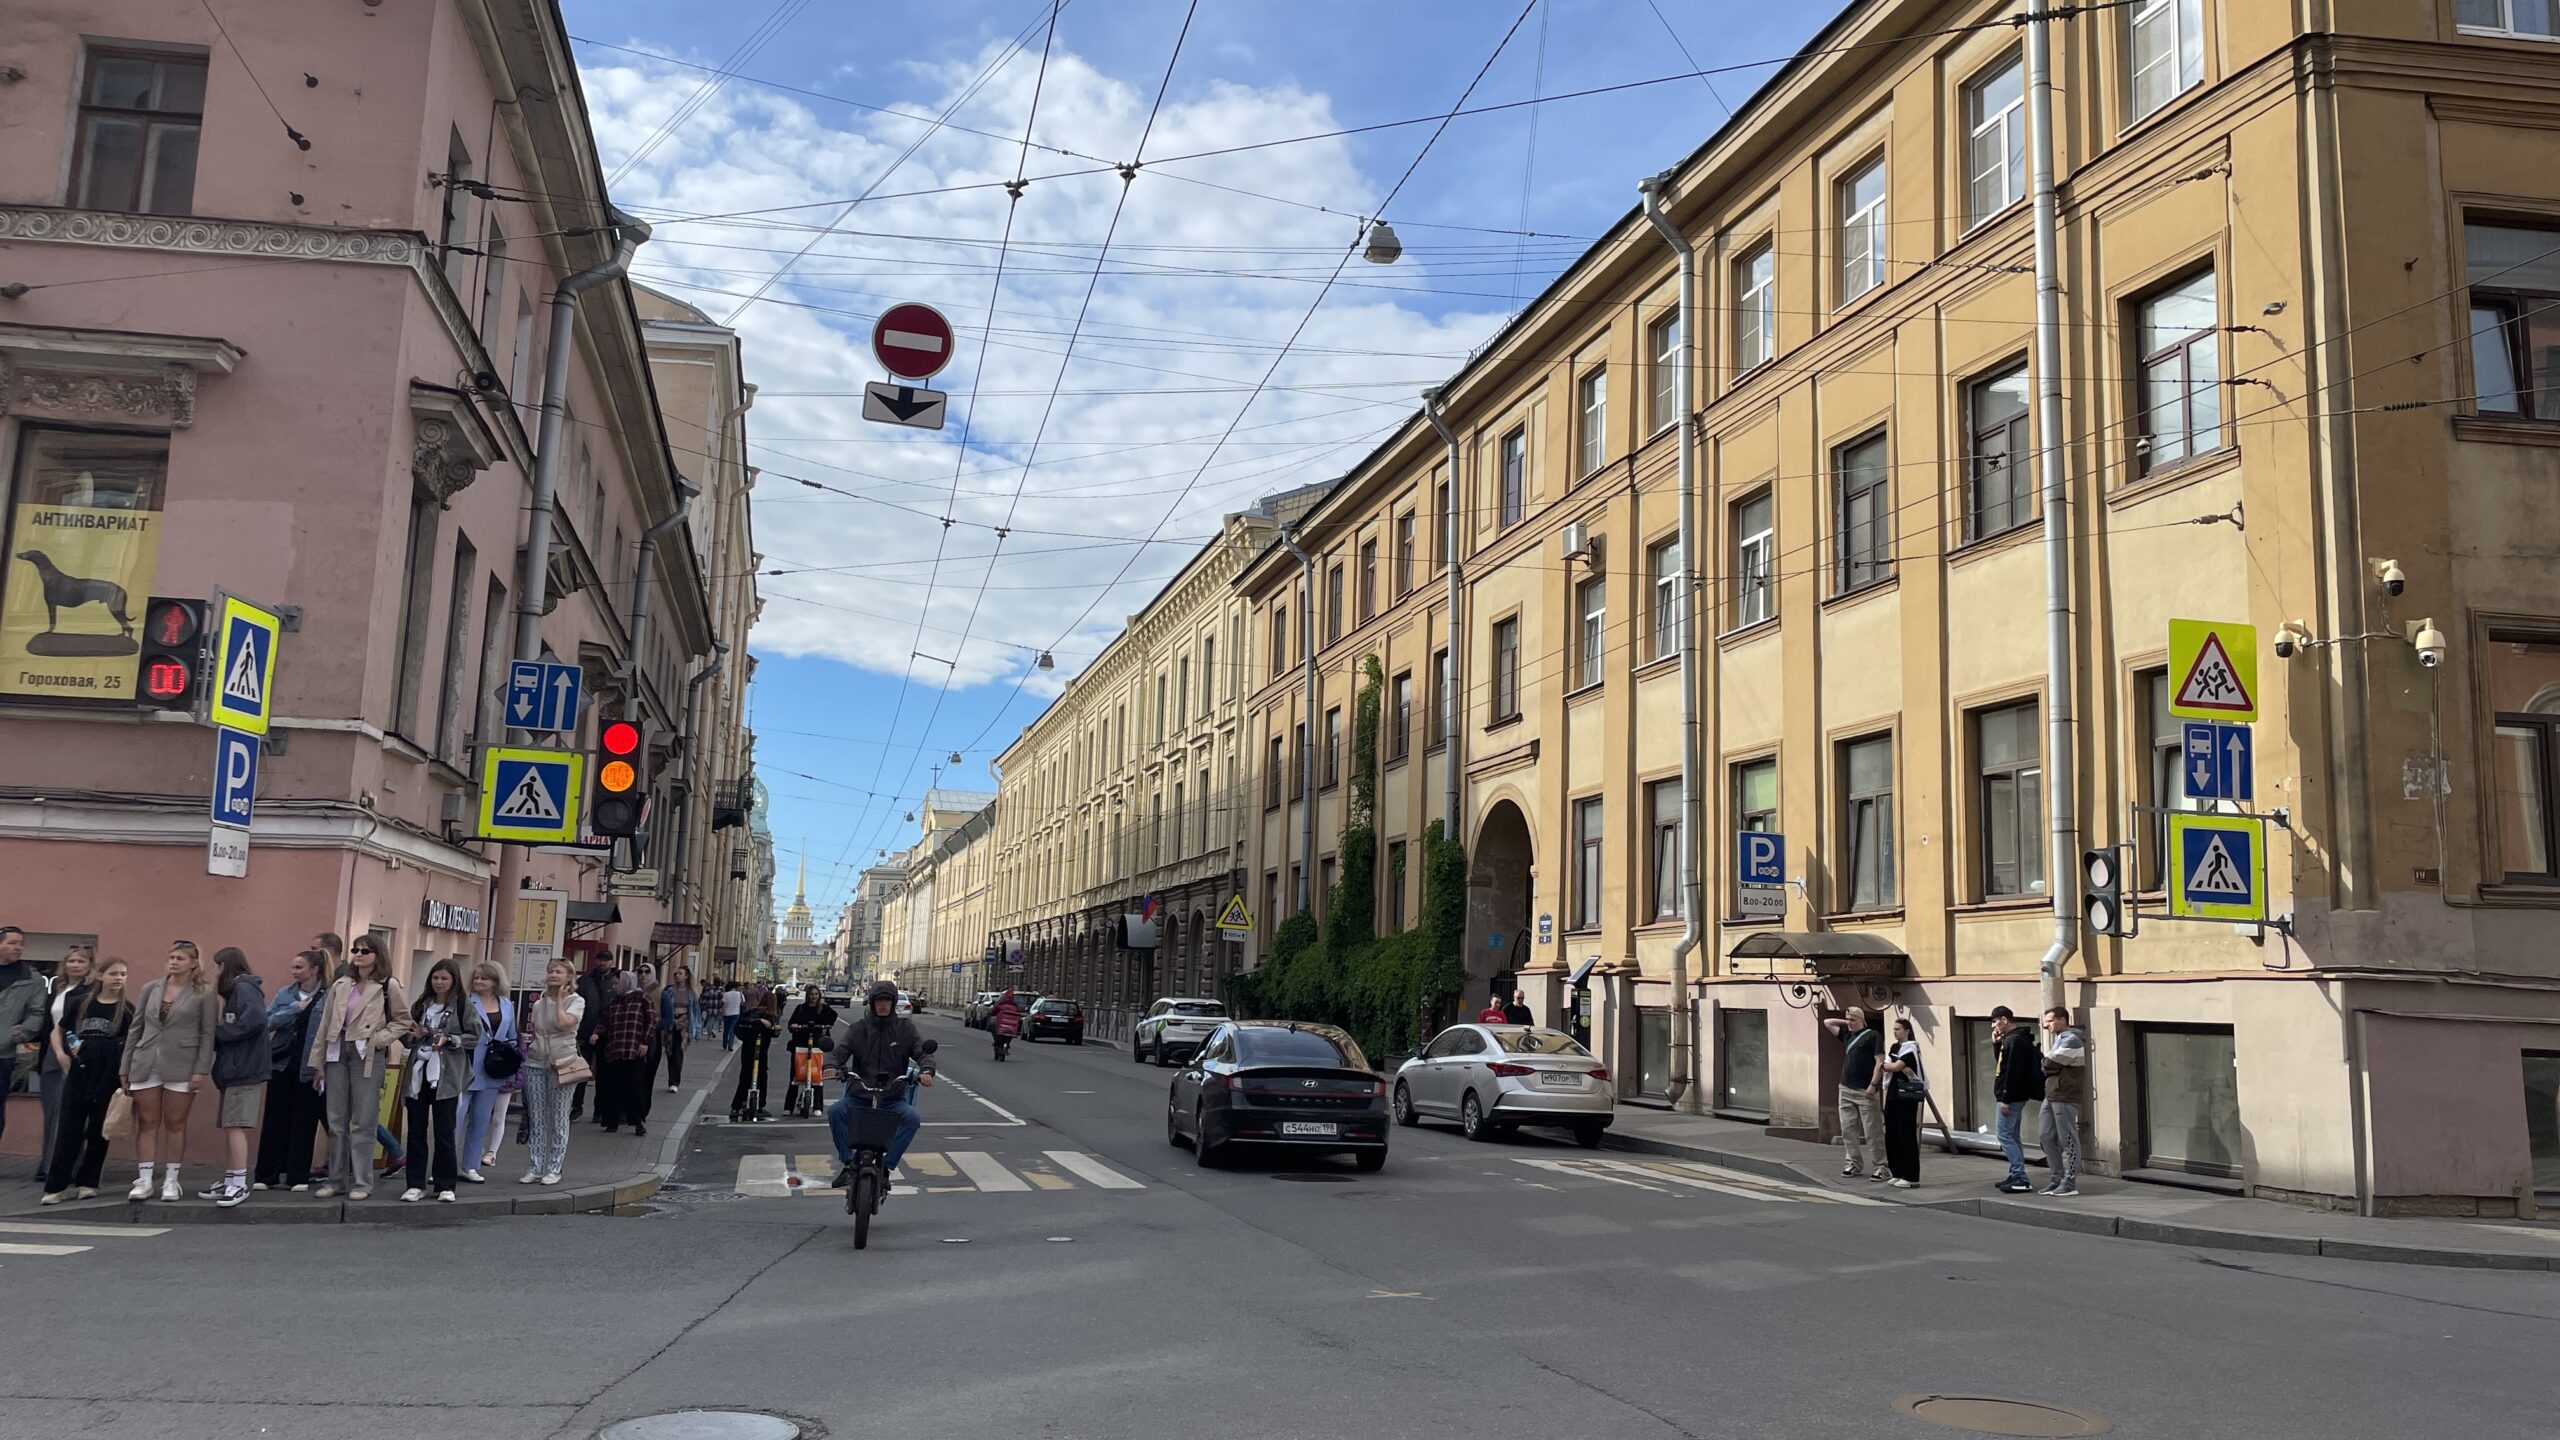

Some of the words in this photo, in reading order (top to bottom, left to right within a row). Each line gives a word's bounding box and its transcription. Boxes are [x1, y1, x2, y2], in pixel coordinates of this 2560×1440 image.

[31, 511, 149, 532] АНТИКВАРИАТ
[19, 671, 98, 690] Гороховая,
[103, 675, 121, 689] 25
[223, 740, 250, 813] P
[1750, 836, 1776, 877] P
[427, 899, 447, 929] ЛАВКА
[537, 902, 548, 942] ФАРФОР
